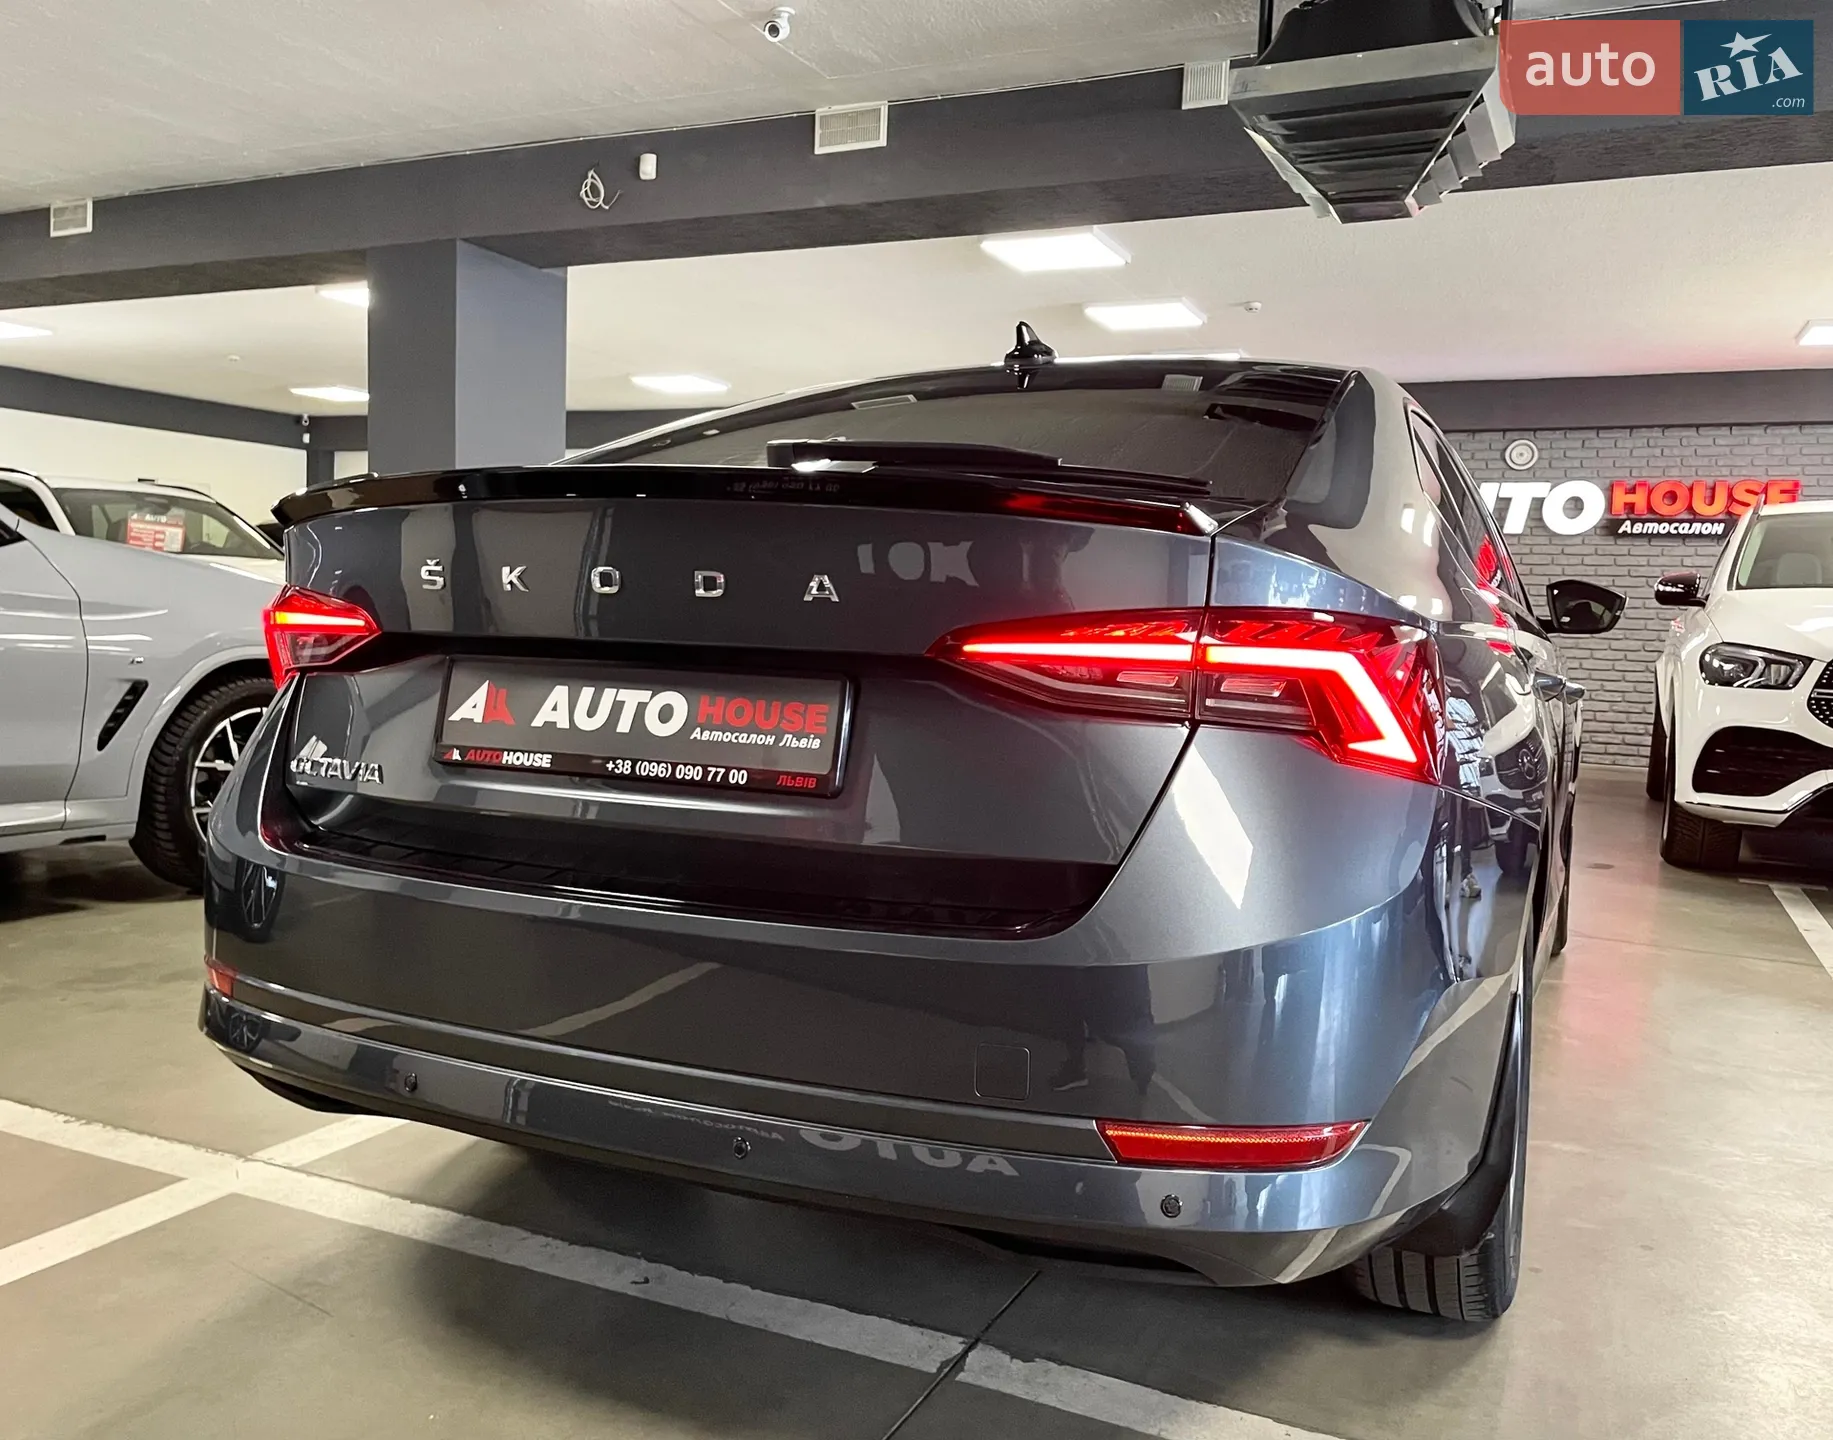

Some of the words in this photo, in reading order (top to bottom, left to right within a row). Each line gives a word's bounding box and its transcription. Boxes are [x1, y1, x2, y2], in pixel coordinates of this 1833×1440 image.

[1610, 478, 1801, 517] HOUSE
[1617, 519, 1726, 536] Автосалон
[419, 558, 840, 603] ŠKODA
[530, 685, 689, 737] AUTO
[696, 694, 830, 735] HOUSE
[689, 727, 776, 746] Автосалон
[778, 733, 822, 750] Львів
[290, 757, 383, 784] OCTAVIA
[605, 759, 632, 775] +38
[635, 760, 672, 778] (096)
[675, 764, 703, 781] 090
[707, 766, 726, 783] 77
[728, 769, 748, 785] 00
[776, 774, 818, 789] ЛЬВІВ
